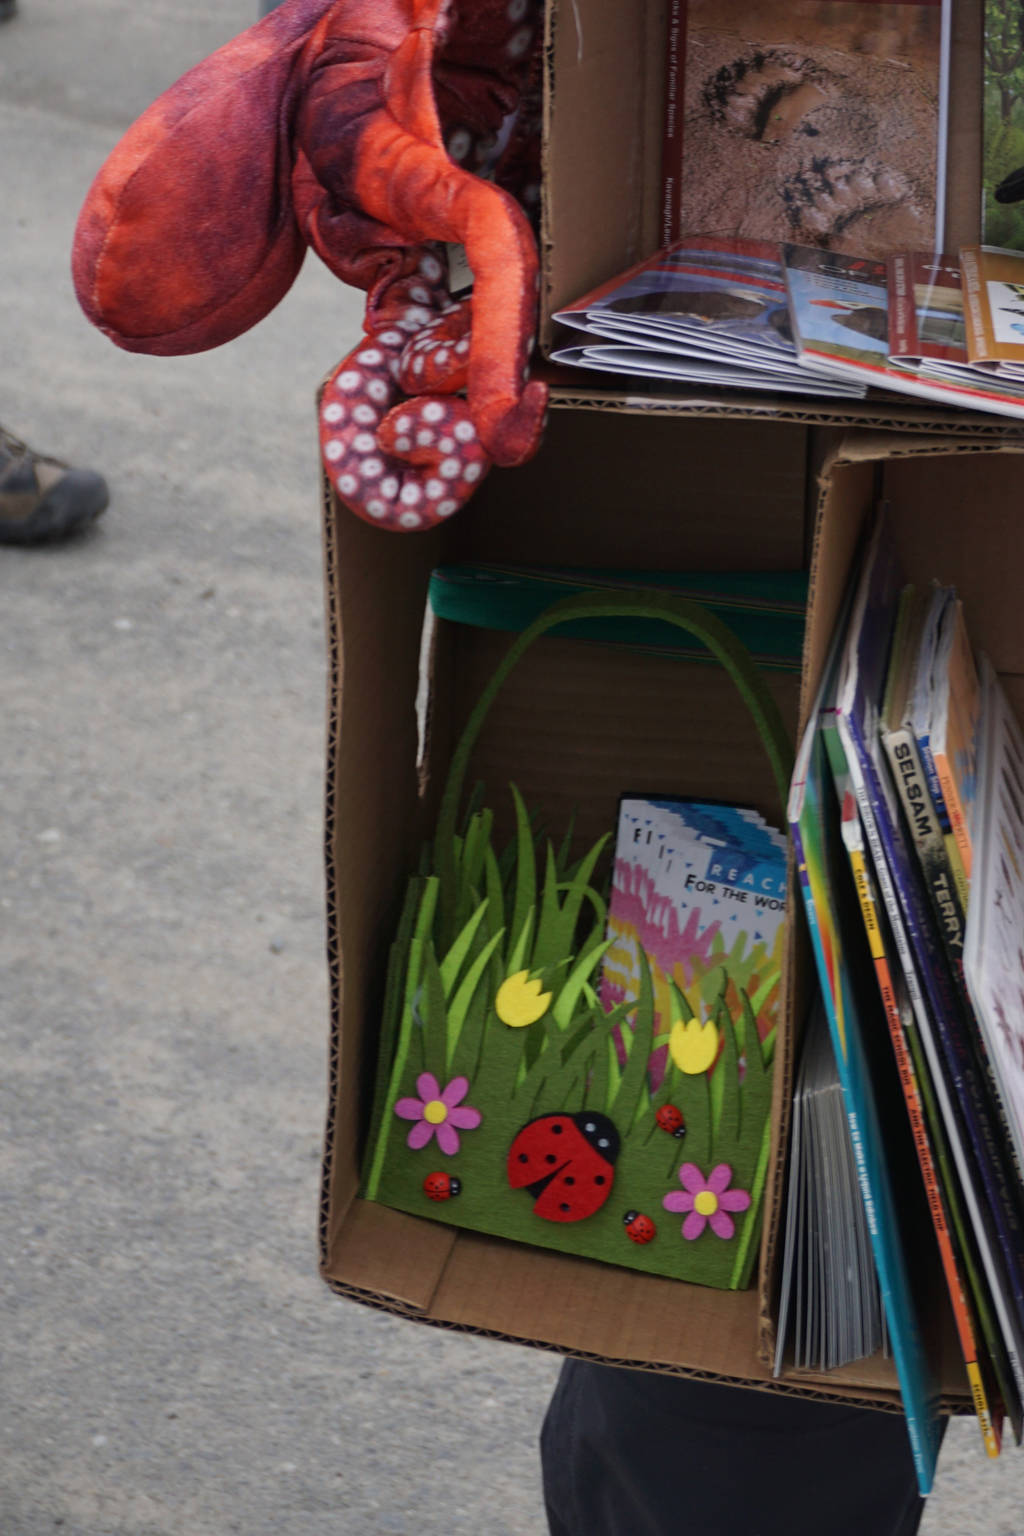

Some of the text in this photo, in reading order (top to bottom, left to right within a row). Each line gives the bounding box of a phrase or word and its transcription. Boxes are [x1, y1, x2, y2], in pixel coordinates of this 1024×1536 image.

[894, 742, 933, 838] SELSAM
[684, 874, 716, 895] FOR
[722, 887, 747, 904] THE
[932, 872, 964, 948] TERRY
[881, 986, 911, 1086] THE MAGIC SCHOOL BUS
[910, 1108, 946, 1233] AND THE ELECTRIC FIELD TRIP
